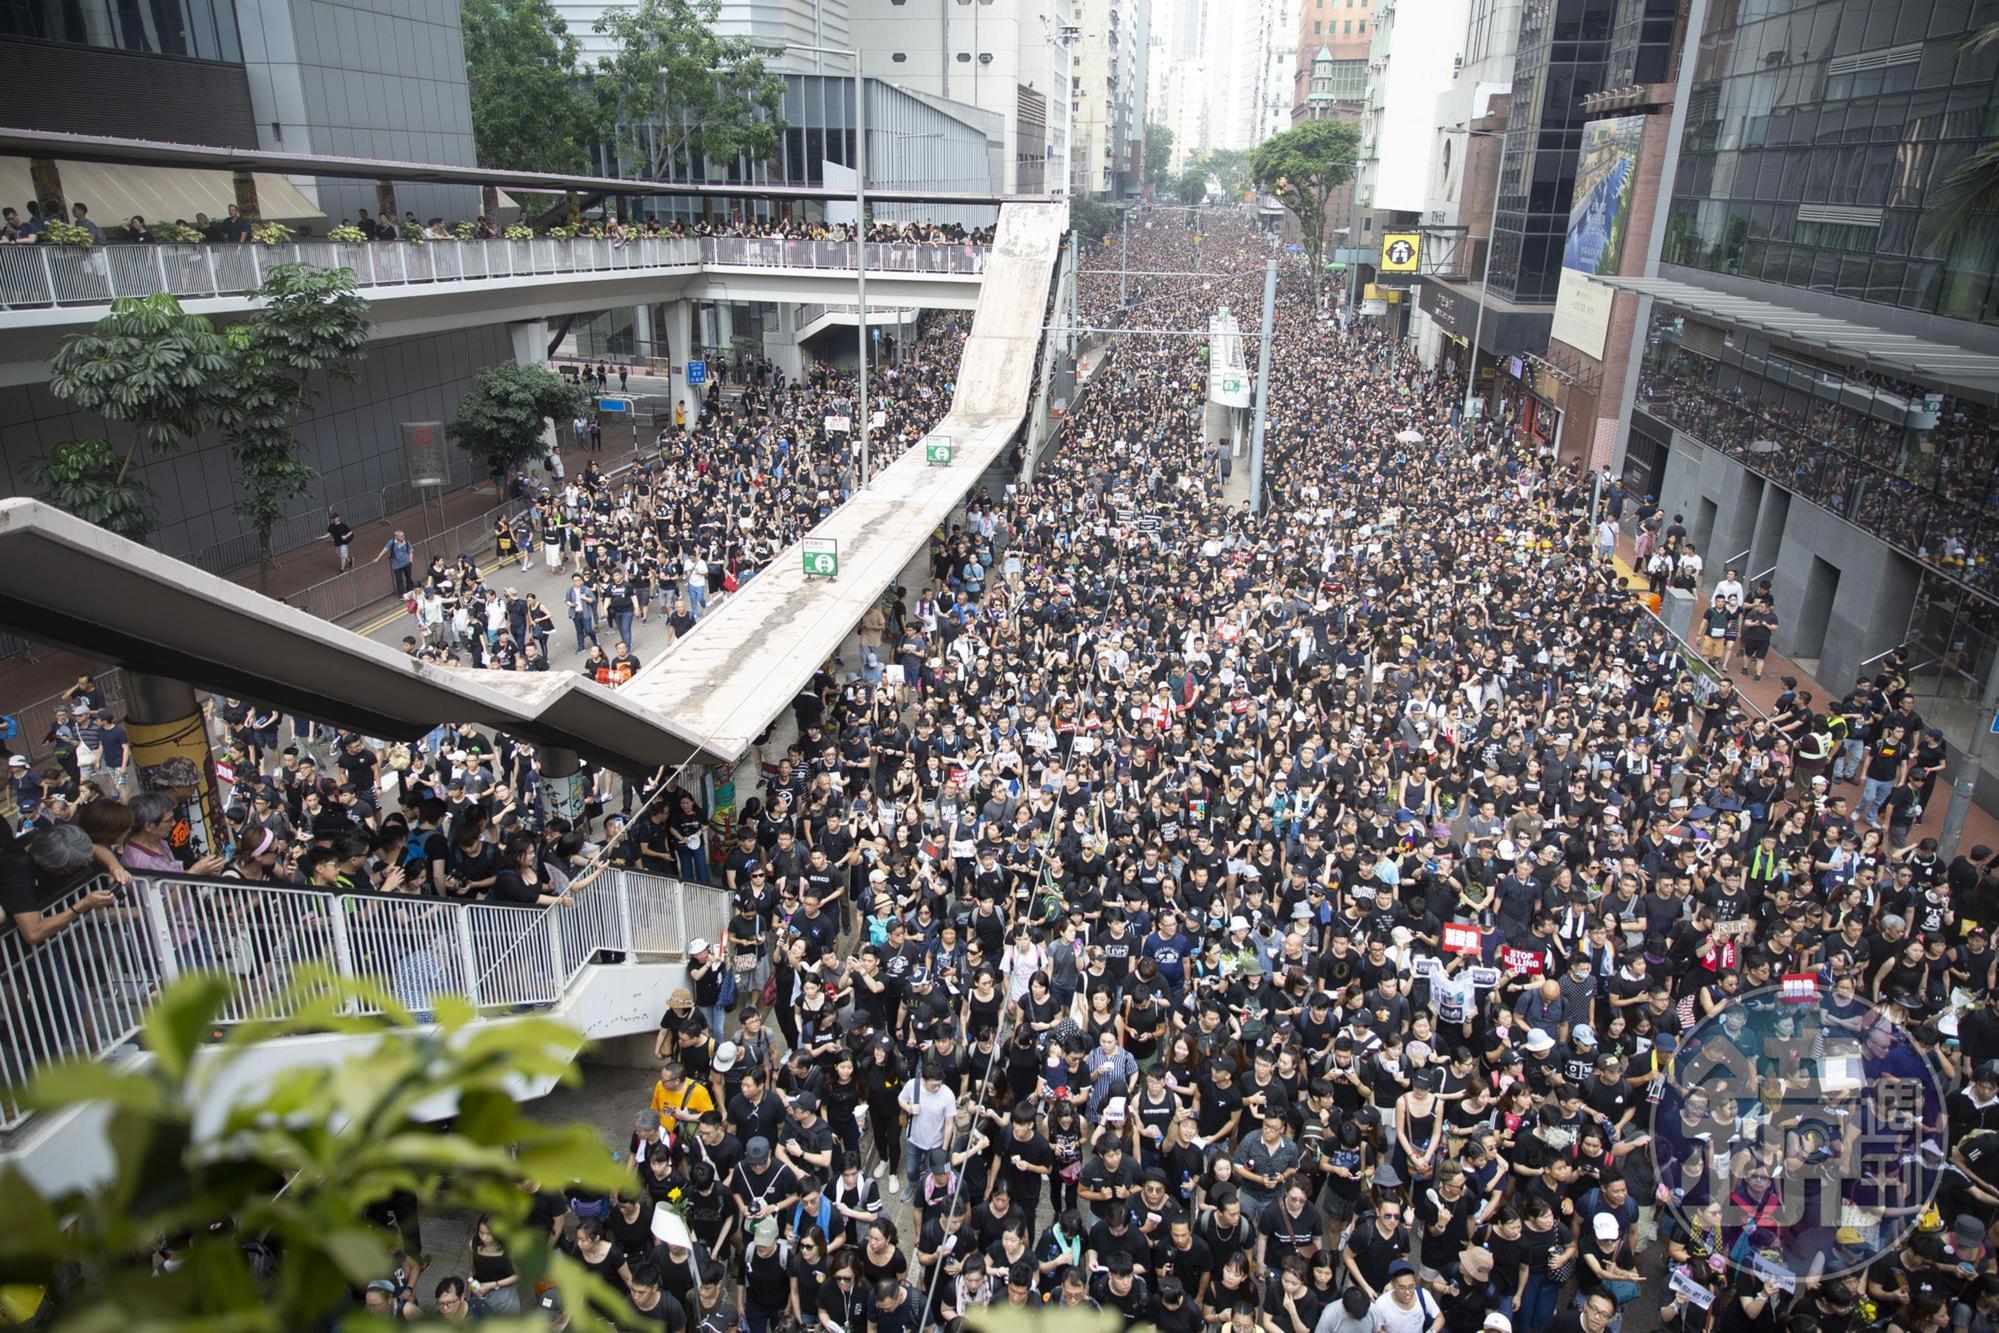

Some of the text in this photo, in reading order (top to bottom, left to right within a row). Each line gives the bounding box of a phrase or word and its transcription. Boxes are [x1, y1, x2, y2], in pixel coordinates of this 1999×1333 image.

[809, 875, 830, 883] MEXICO
[1509, 949, 1534, 960] STOP
[1504, 955, 1539, 968] KILLING
[1515, 965, 1527, 974] US
